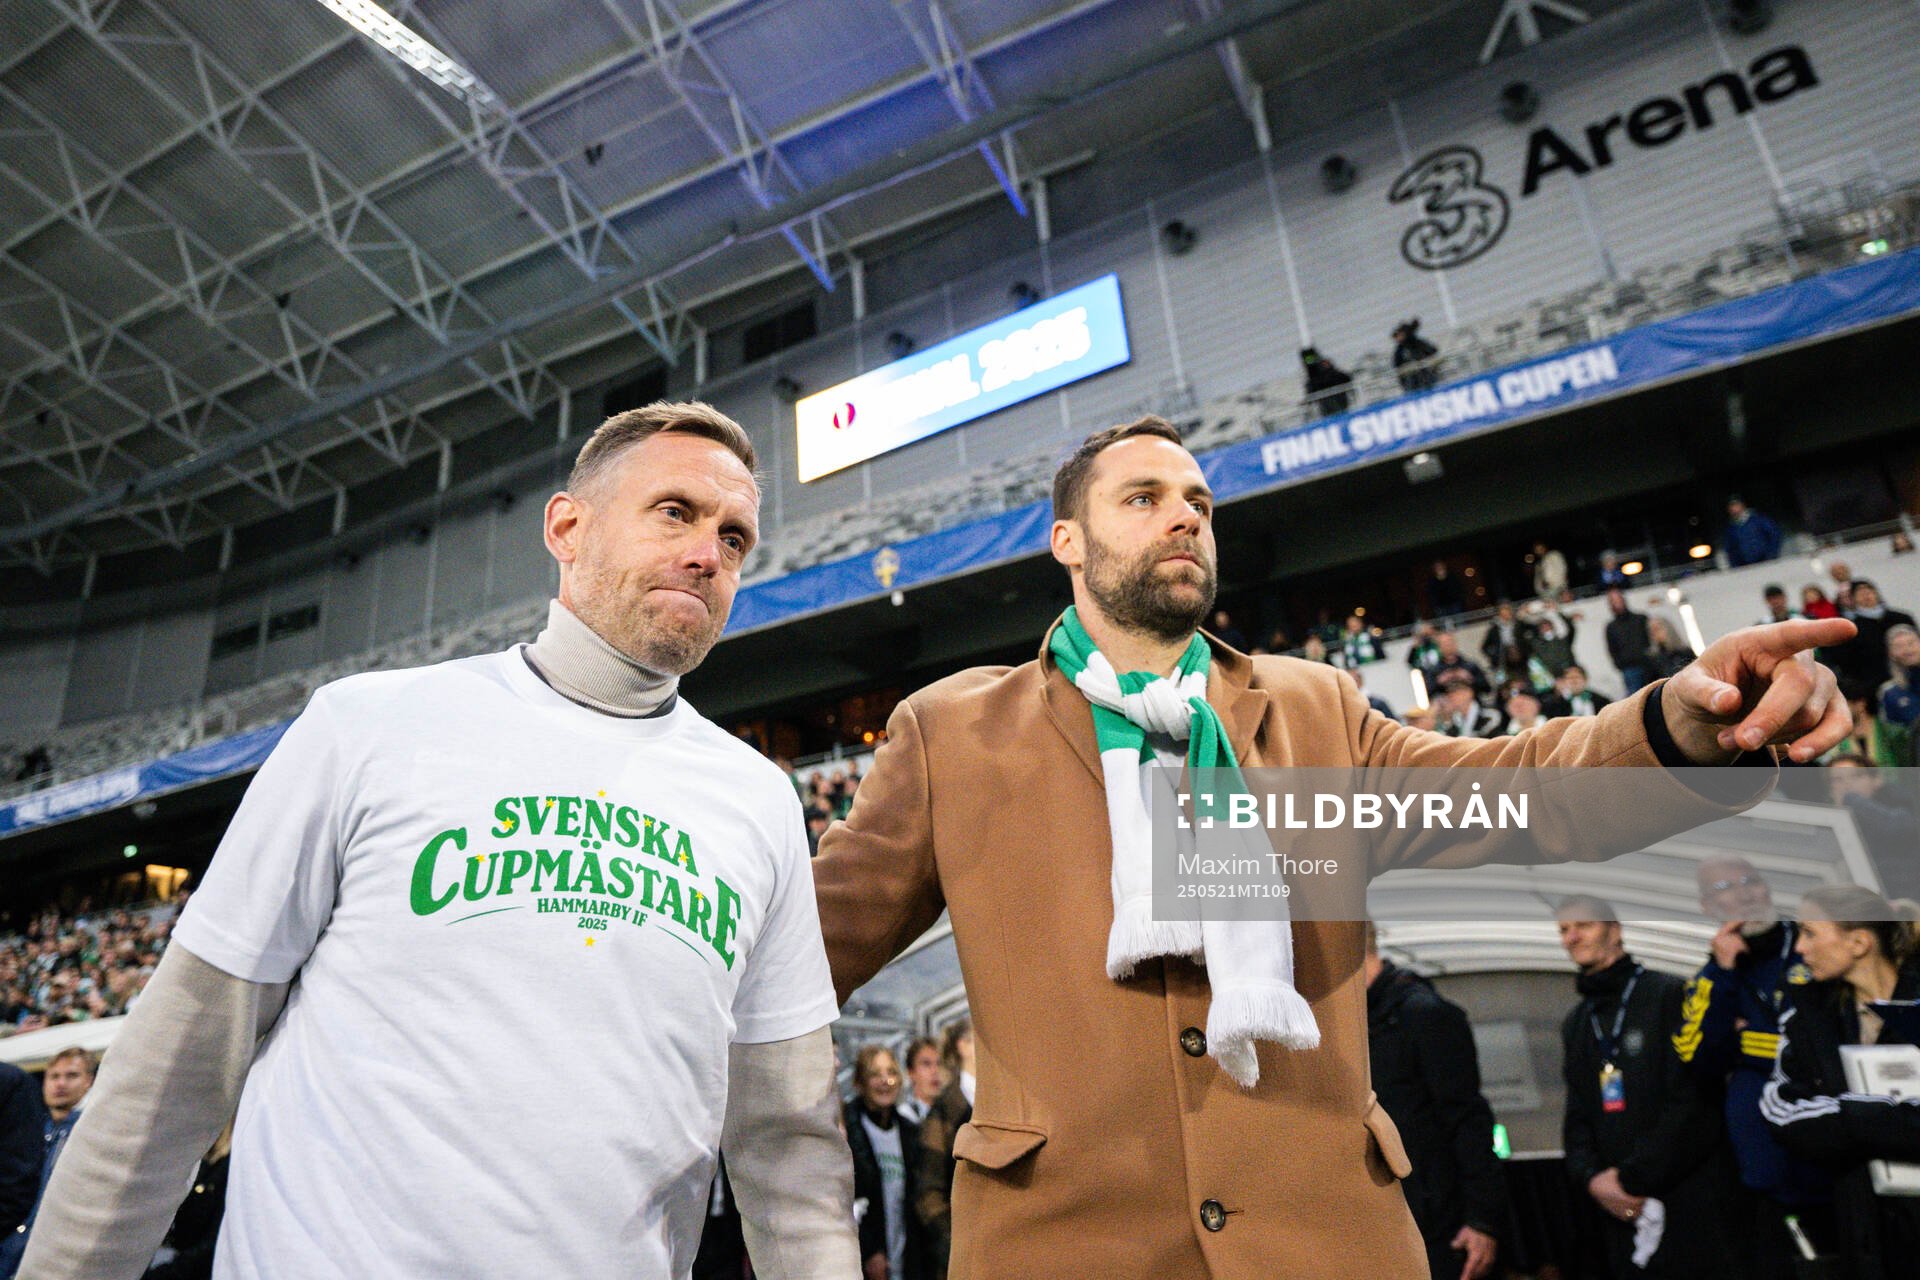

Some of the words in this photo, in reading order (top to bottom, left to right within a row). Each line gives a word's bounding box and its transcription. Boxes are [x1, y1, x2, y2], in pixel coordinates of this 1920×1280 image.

[1521, 43, 1820, 197] Arena
[1260, 420, 1351, 476] FINAL
[1348, 379, 1502, 451] SVENSKA
[1499, 344, 1620, 409] CUPEN
[491, 796, 700, 878] SVENSKA
[409, 826, 742, 972] CUPMÄSTARE
[537, 897, 631, 921] HAMMARBY
[633, 910, 649, 928] IF
[577, 916, 609, 931] 2025
